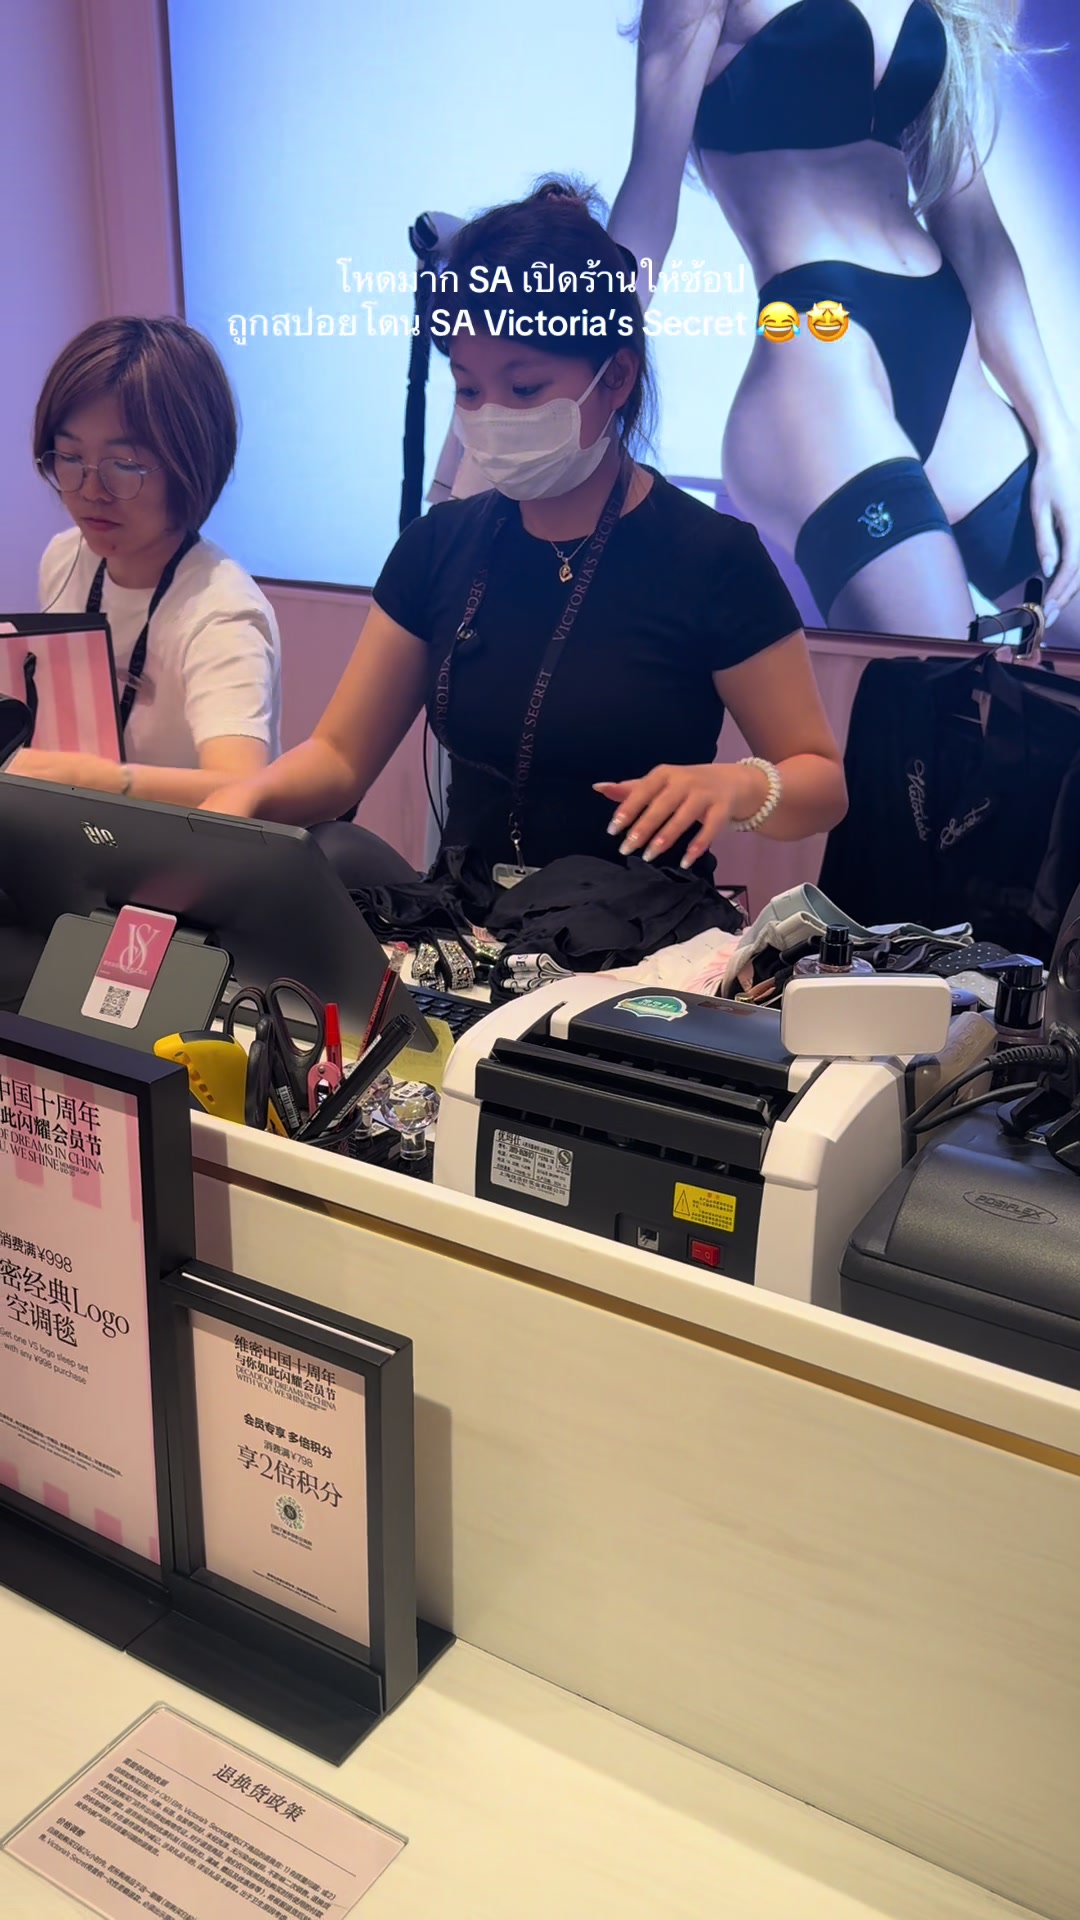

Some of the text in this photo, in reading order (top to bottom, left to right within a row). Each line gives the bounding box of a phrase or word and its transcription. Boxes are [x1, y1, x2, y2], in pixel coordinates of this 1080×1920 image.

[525, 668, 552, 728] SECRET
[10, 1143, 27, 1159] WE
[11, 1131, 53, 1156] DREAMS
[55, 1146, 66, 1160] IN
[68, 1151, 104, 1174] CHINA
[975, 1195, 1046, 1218] POSIFLEX
[6, 1293, 78, 1348] 空调毯
[234, 1334, 336, 1386] 维密中国十周年
[236, 1365, 263, 1381] DECADE
[275, 1380, 304, 1397] DREAMS
[244, 1413, 333, 1459] 会员专享 多倍积分
[237, 1444, 343, 1508] 享2倍积分
[212, 1763, 306, 1823] 退换货政策
